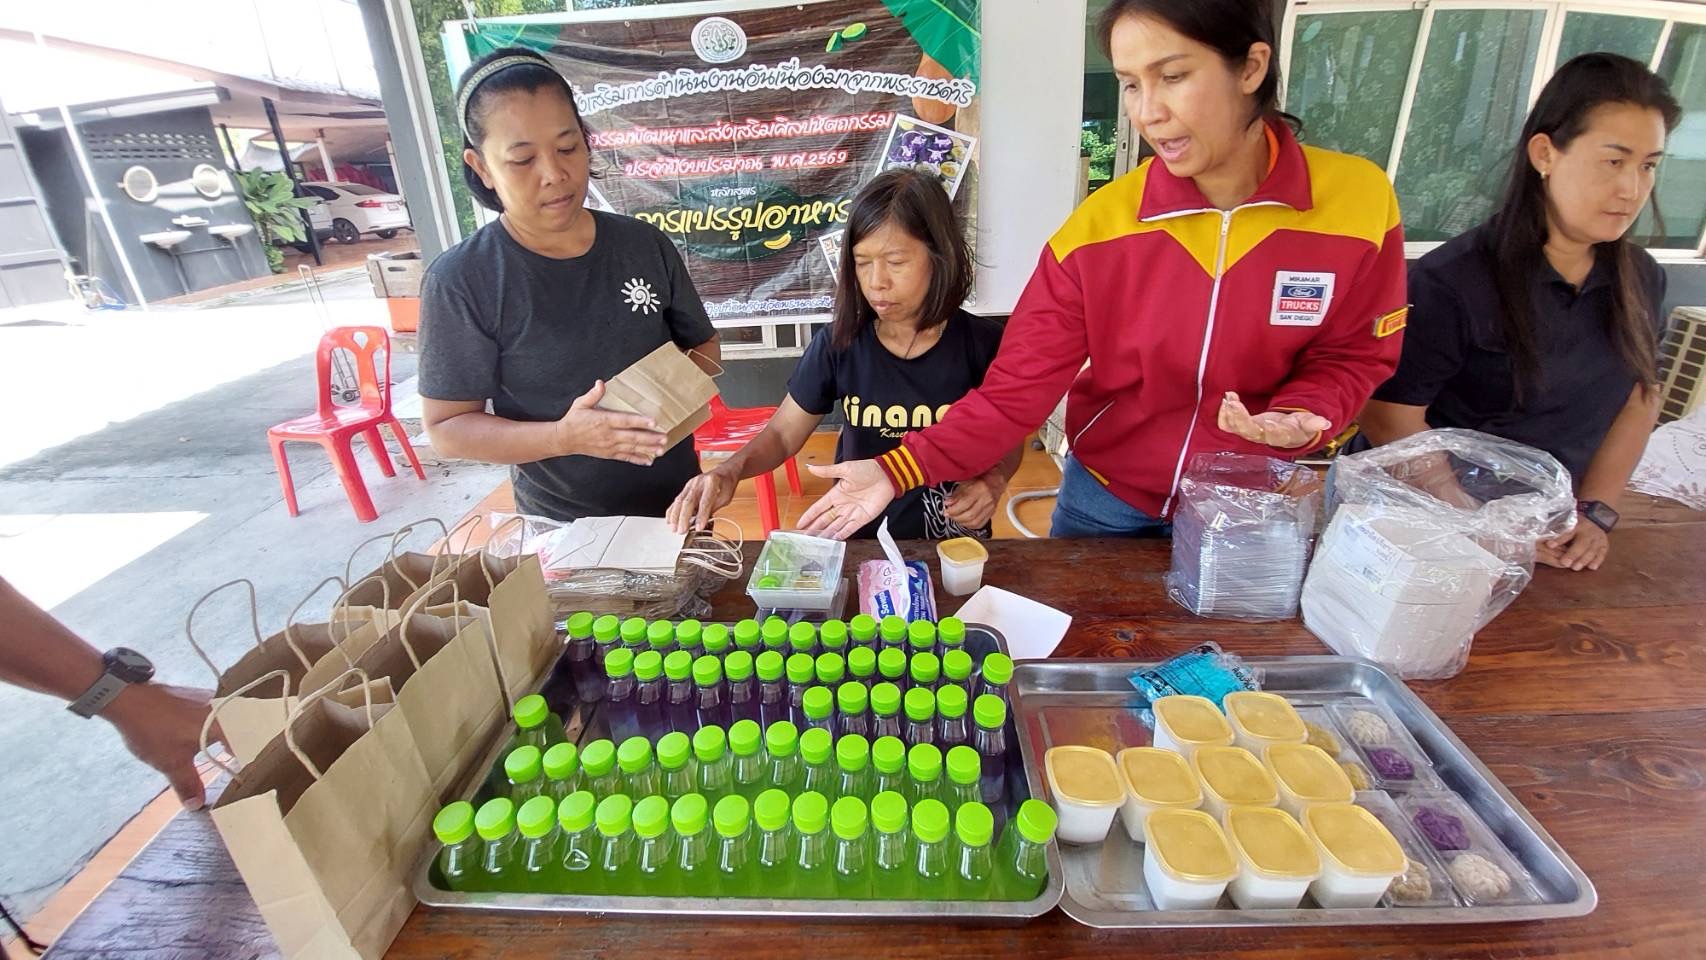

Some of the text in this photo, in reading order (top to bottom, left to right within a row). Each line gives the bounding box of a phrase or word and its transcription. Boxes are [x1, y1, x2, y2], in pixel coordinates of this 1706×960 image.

[575, 60, 974, 113] งเสริมการดำเนินงานอันเนื่องมาจากพระราชดำริ
[771, 151, 847, 169] พ.ศ.2569
[710, 186, 757, 200] หลักสูตร
[1281, 300, 1320, 311] TRUCKS
